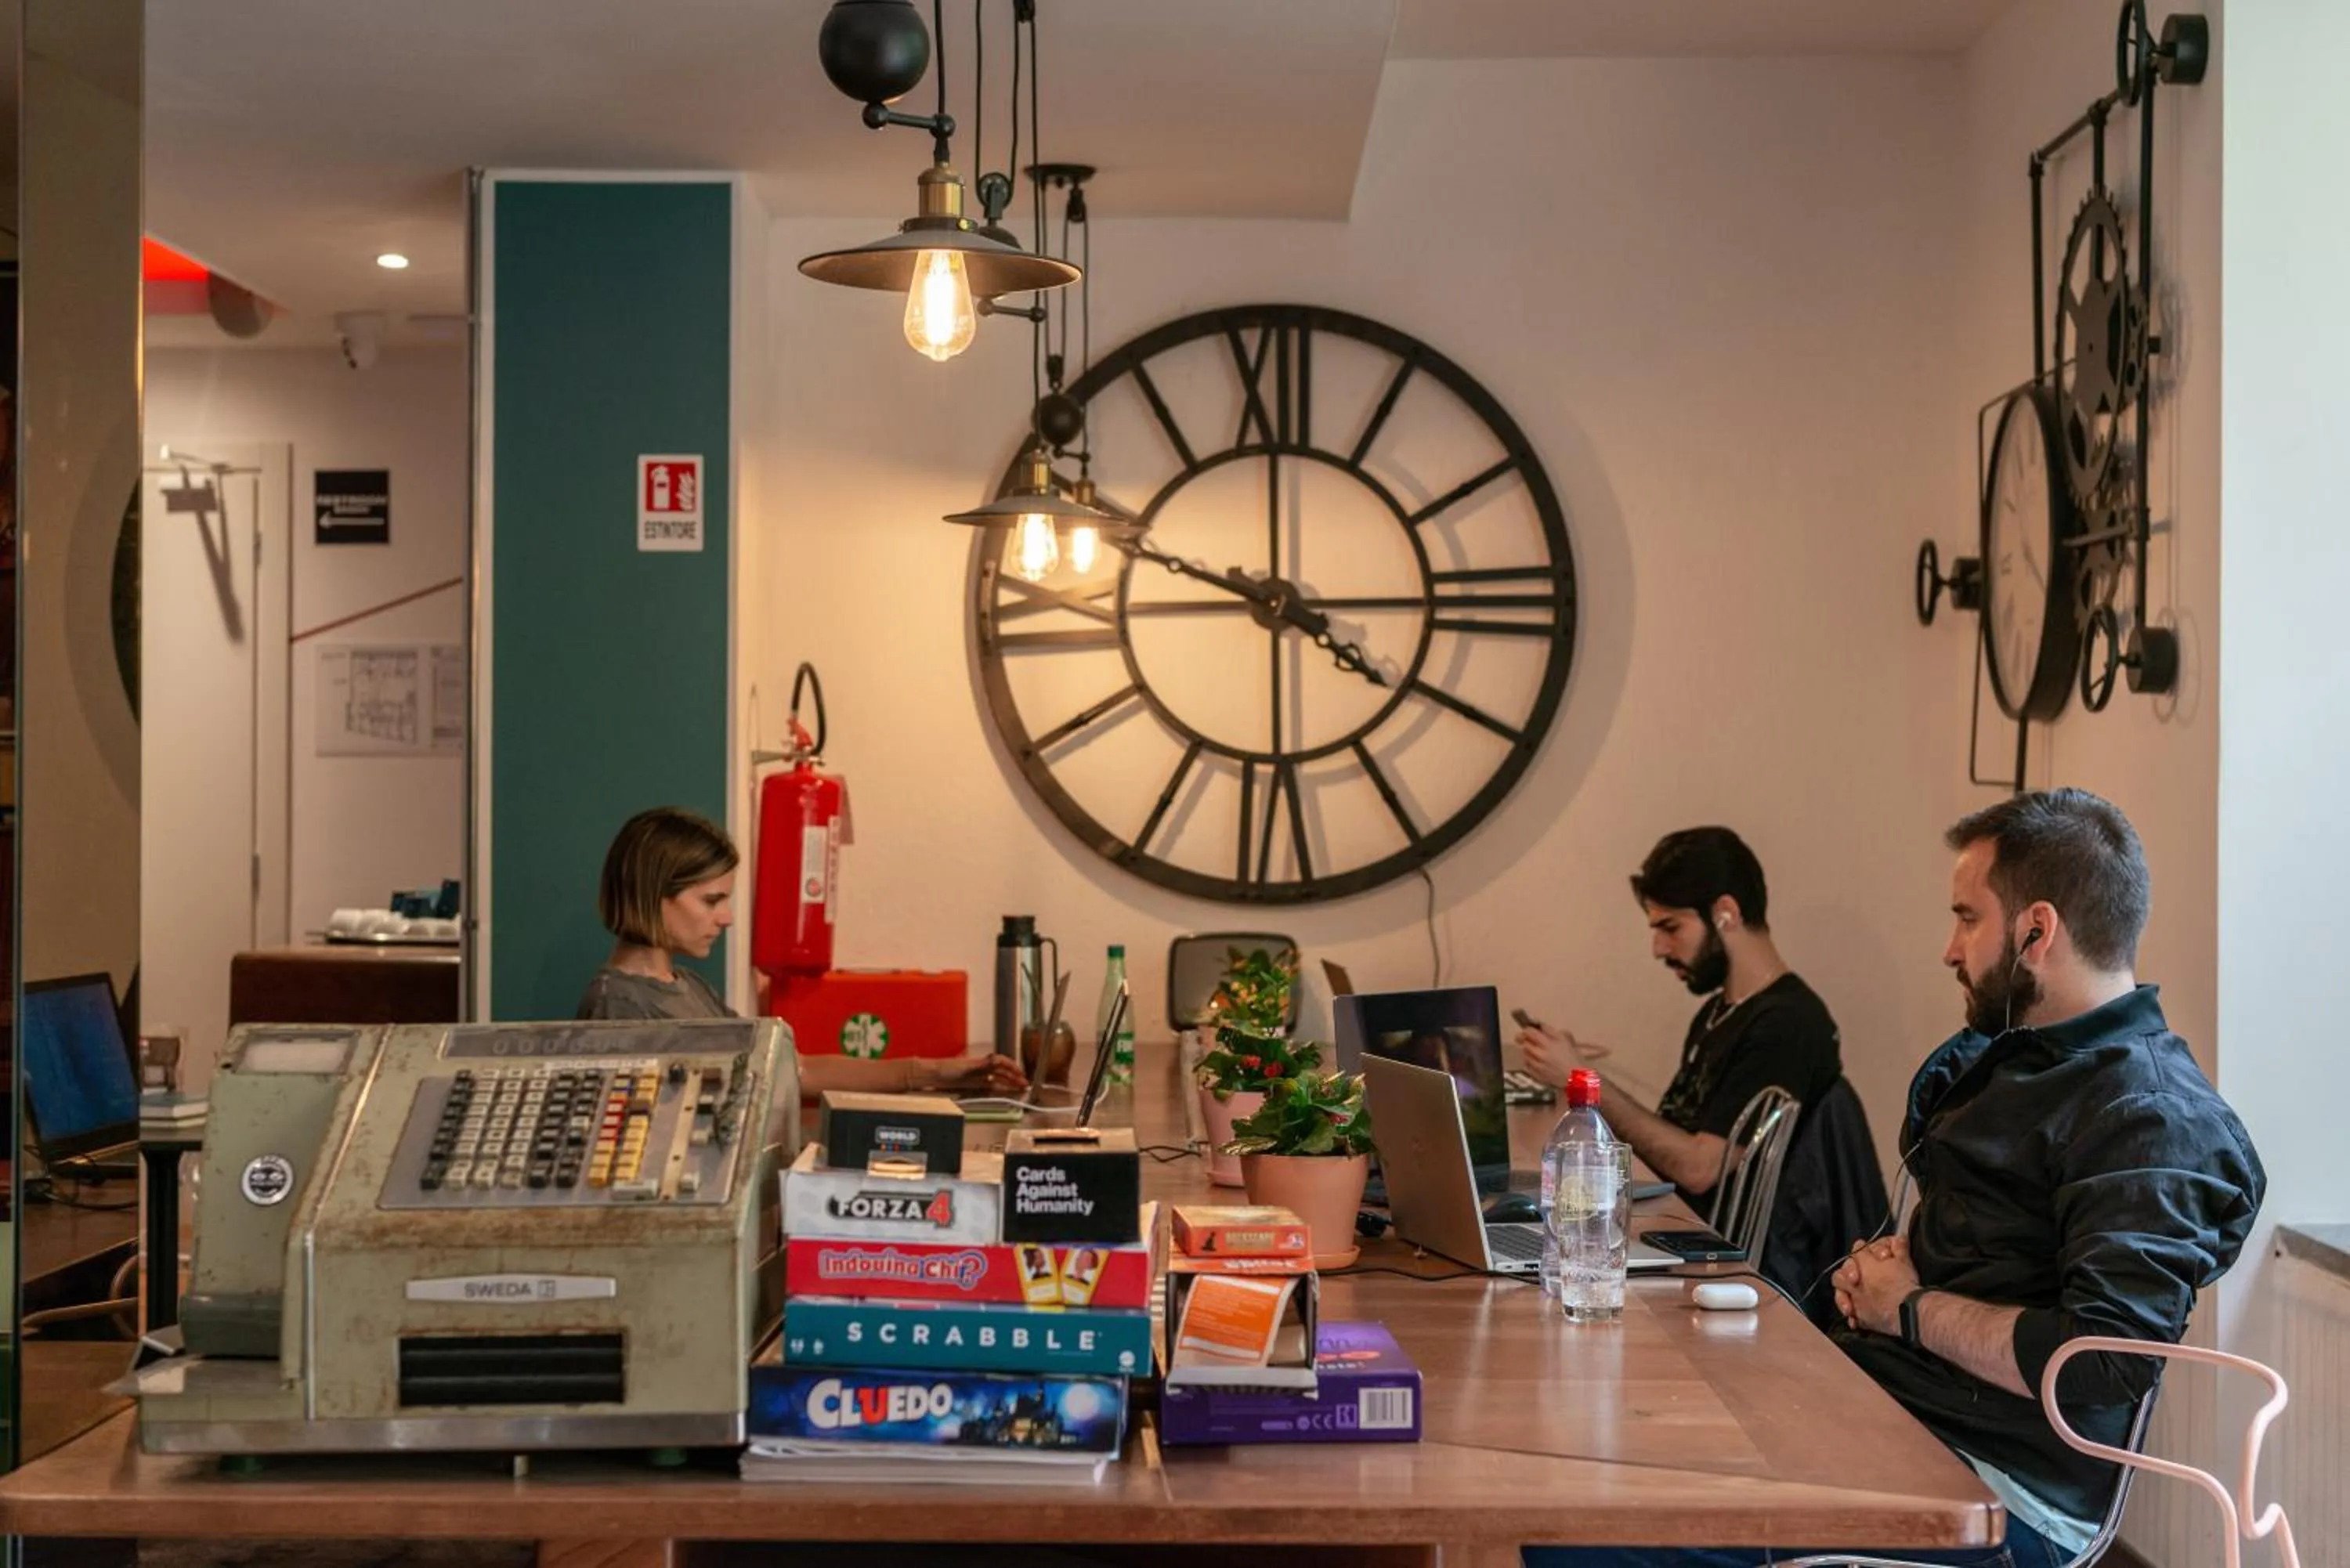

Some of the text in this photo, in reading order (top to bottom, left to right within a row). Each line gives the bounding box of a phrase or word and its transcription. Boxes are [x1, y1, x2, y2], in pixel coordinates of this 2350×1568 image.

[1016, 1166, 1066, 1183] Cards
[1016, 1182, 1078, 1201] Against
[837, 1189, 953, 1227] FORZA 4
[1017, 1198, 1094, 1216] Humanity
[925, 1255, 982, 1284] Chi?
[464, 1282, 532, 1299] SWEDA
[847, 1321, 1095, 1351] SCRABBLE
[806, 1378, 953, 1429] CLUEDO
